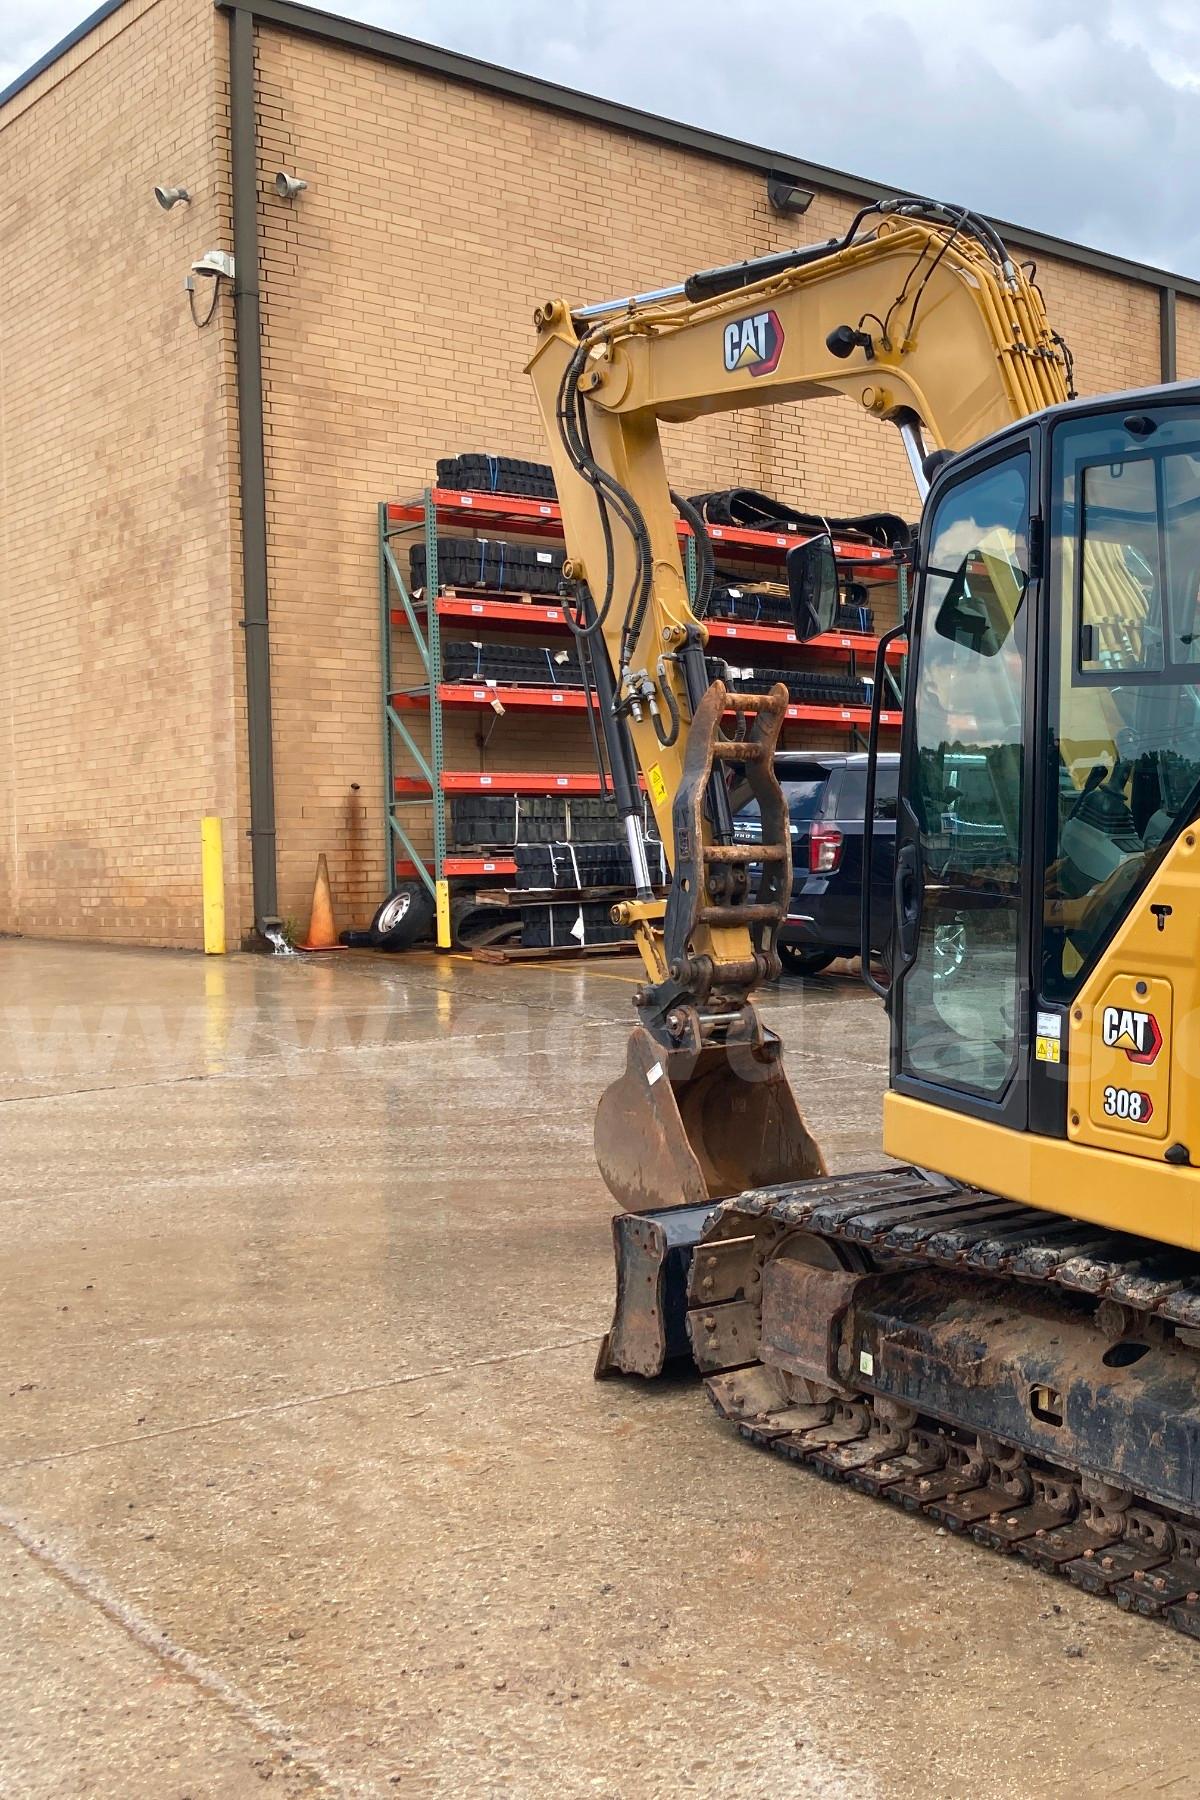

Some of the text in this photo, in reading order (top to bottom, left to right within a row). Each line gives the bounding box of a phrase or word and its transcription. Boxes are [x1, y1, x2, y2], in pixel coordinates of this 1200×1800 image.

[724, 312, 769, 371] CAT
[1103, 1006, 1149, 1052] CAT
[1104, 1087, 1142, 1120] 308
